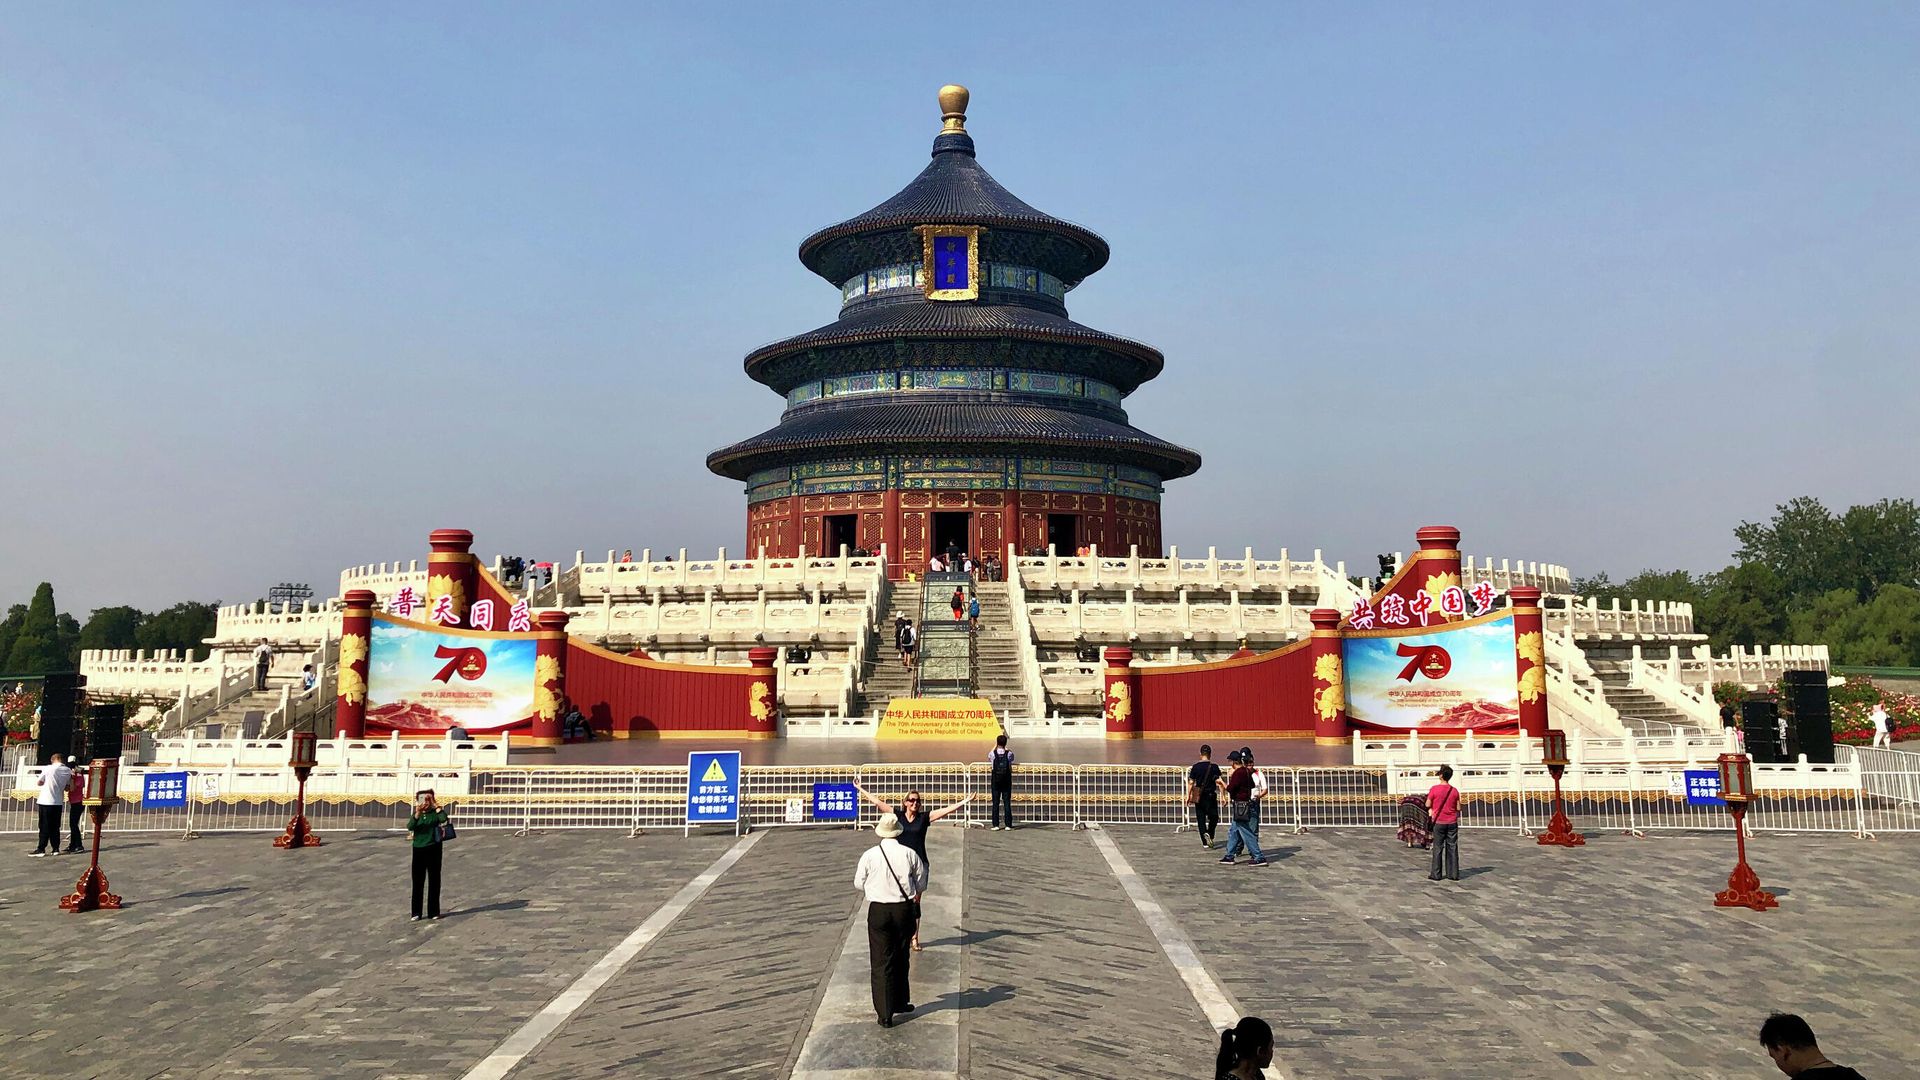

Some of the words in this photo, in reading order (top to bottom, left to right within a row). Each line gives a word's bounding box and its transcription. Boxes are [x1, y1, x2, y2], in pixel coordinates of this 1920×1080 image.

[391, 587, 531, 632] 普天同庆
[1349, 580, 1498, 630] 共筑中国梦
[432, 644, 487, 684] 70
[1396, 642, 1452, 683] 70
[886, 709, 994, 720] 中华人民共和国成立70周年
[149, 780, 183, 790] 正在施工
[818, 790, 853, 800] 正在施工
[1691, 787, 1721, 797] 请勿靠
